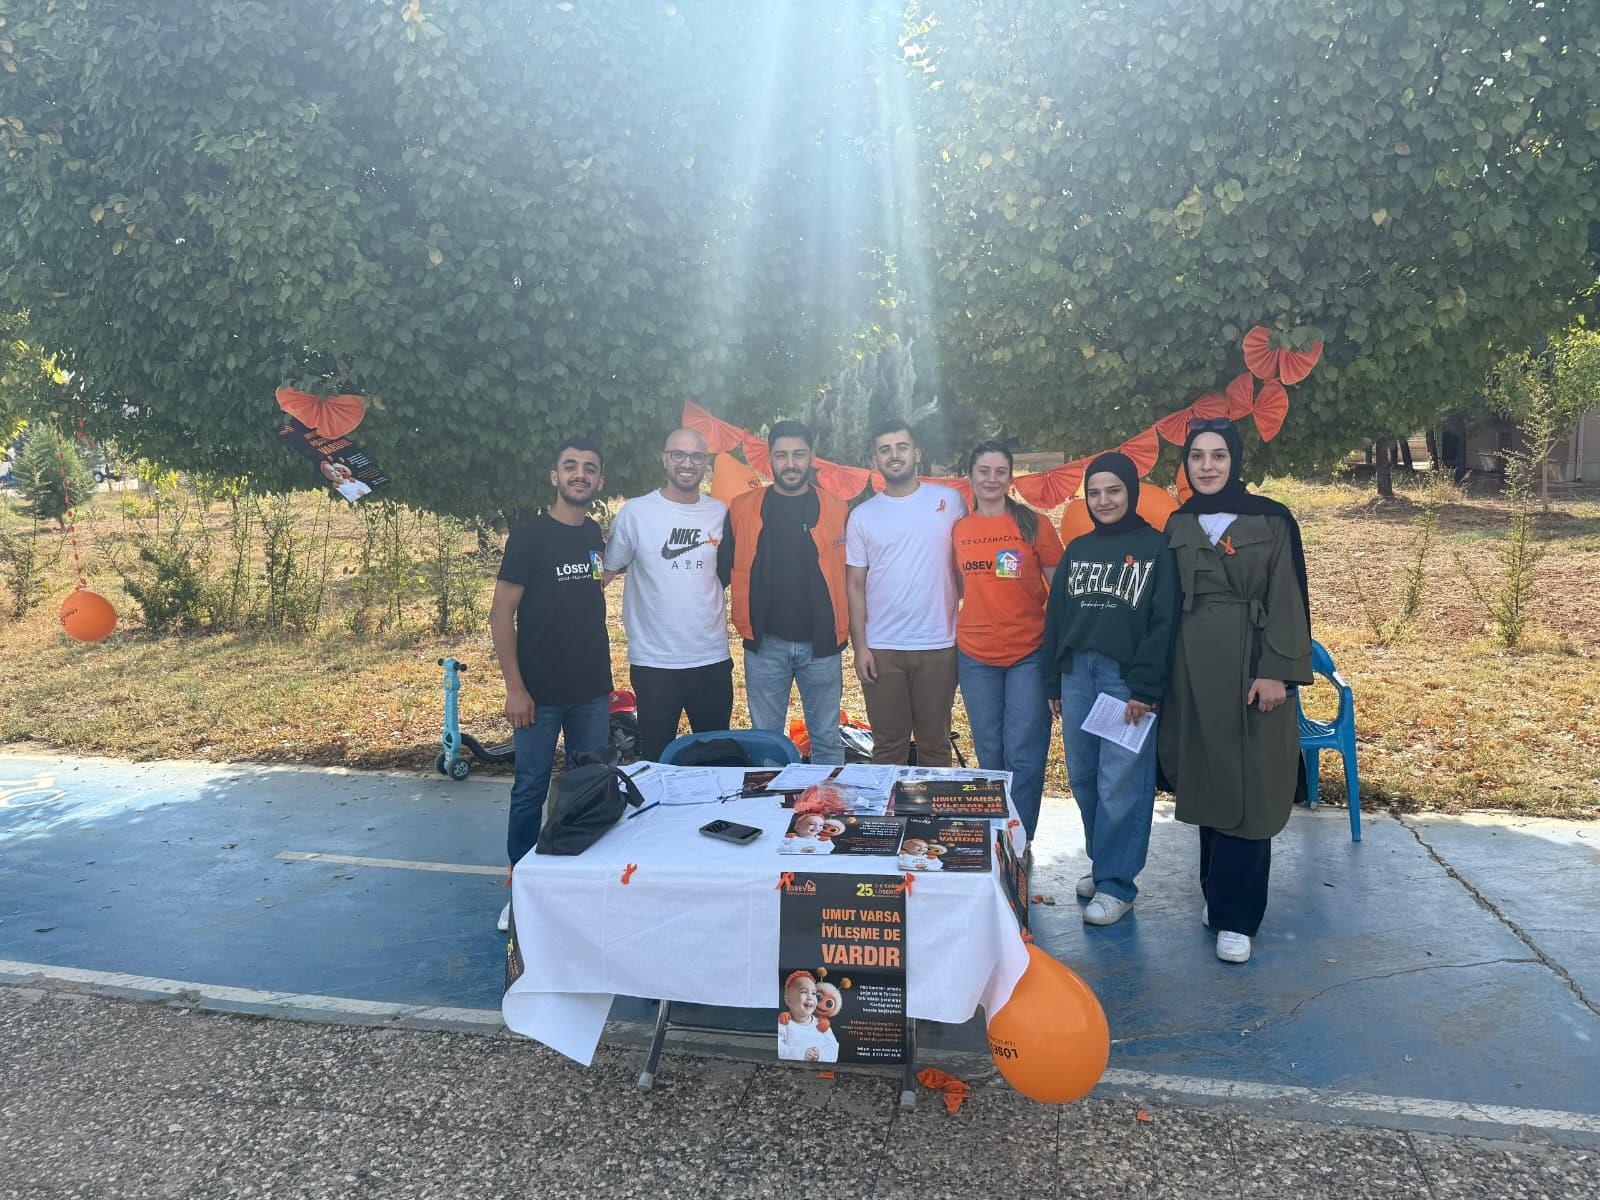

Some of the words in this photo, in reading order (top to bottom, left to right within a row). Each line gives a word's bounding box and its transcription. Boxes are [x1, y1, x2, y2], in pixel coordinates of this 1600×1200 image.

[669, 528, 702, 545] NIKE
[555, 563, 590, 576] LÖSEV
[822, 908, 857, 921] UMUT
[859, 910, 901, 923] VARSA
[821, 922, 881, 943] İYİLEŞME
[884, 928, 901, 941] DE
[821, 943, 901, 967] VARDIR
[991, 1044, 1018, 1060] LÖSE
